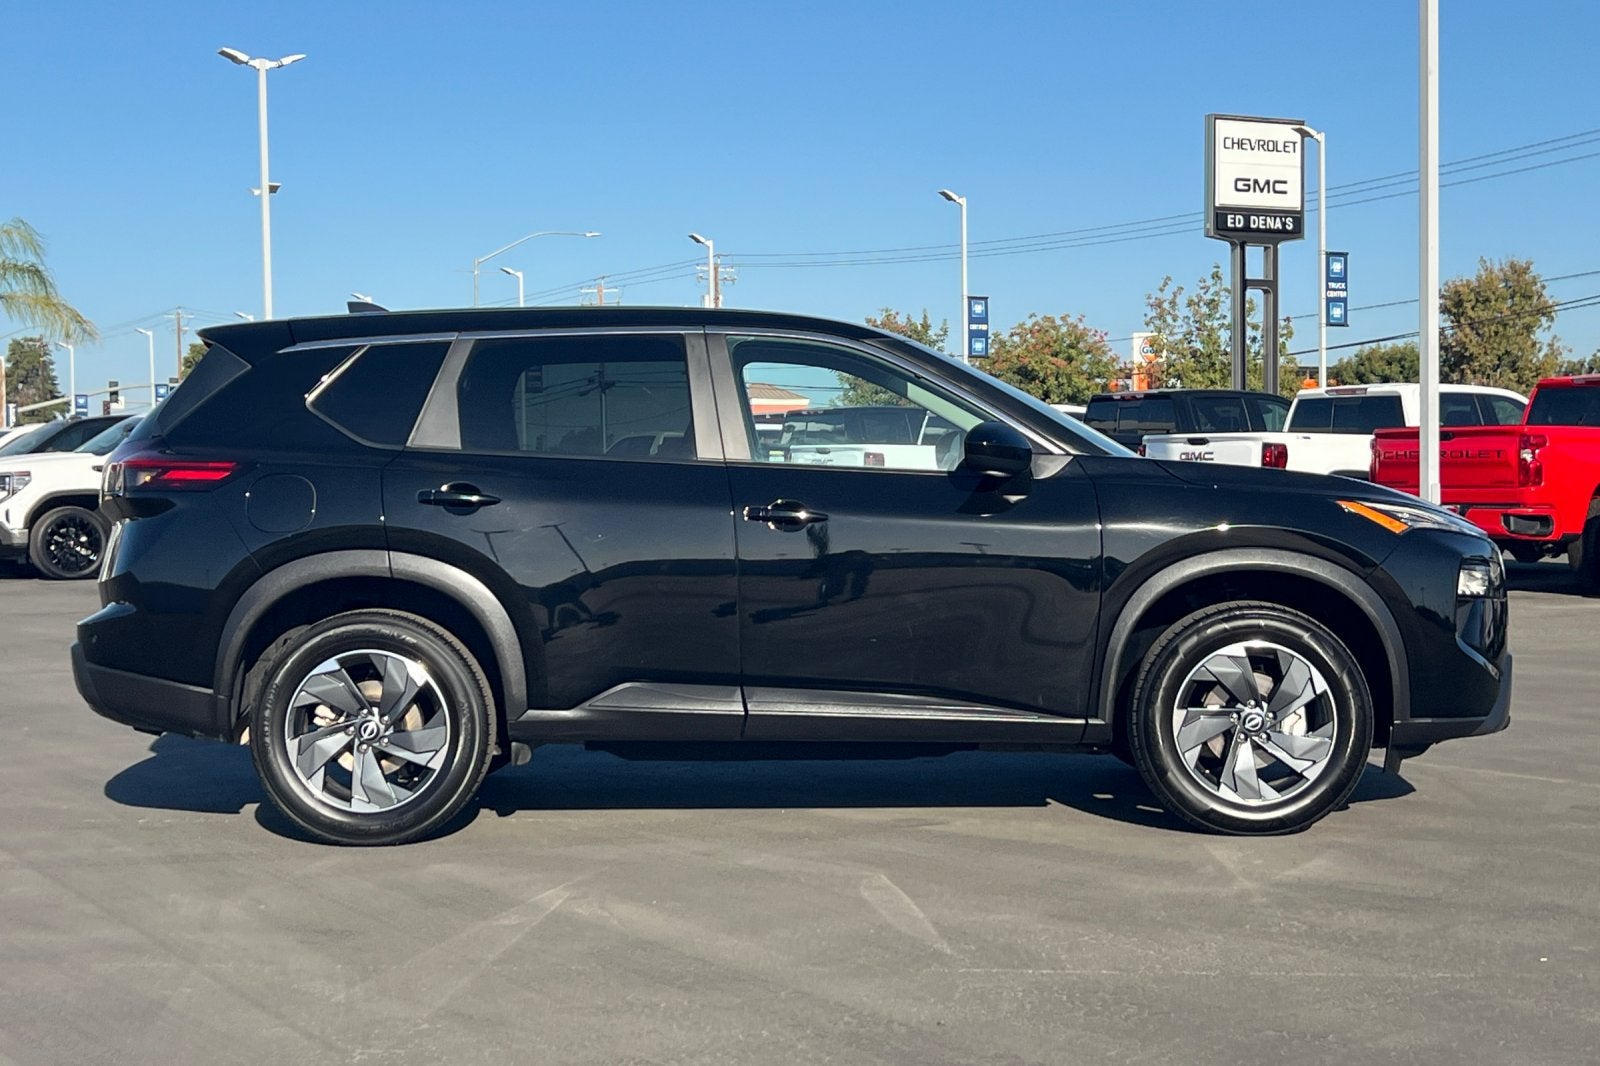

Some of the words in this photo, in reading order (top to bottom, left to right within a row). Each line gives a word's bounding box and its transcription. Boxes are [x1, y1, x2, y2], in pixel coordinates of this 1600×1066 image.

[1223, 136, 1298, 154] CHEVROLET
[1234, 177, 1288, 194] GMC
[1227, 214, 1244, 228] ED
[1250, 215, 1294, 230] DENA'S
[1327, 290, 1347, 298] CENTER
[1180, 451, 1214, 461] GMC
[1383, 449, 1505, 460] CHEROLET
